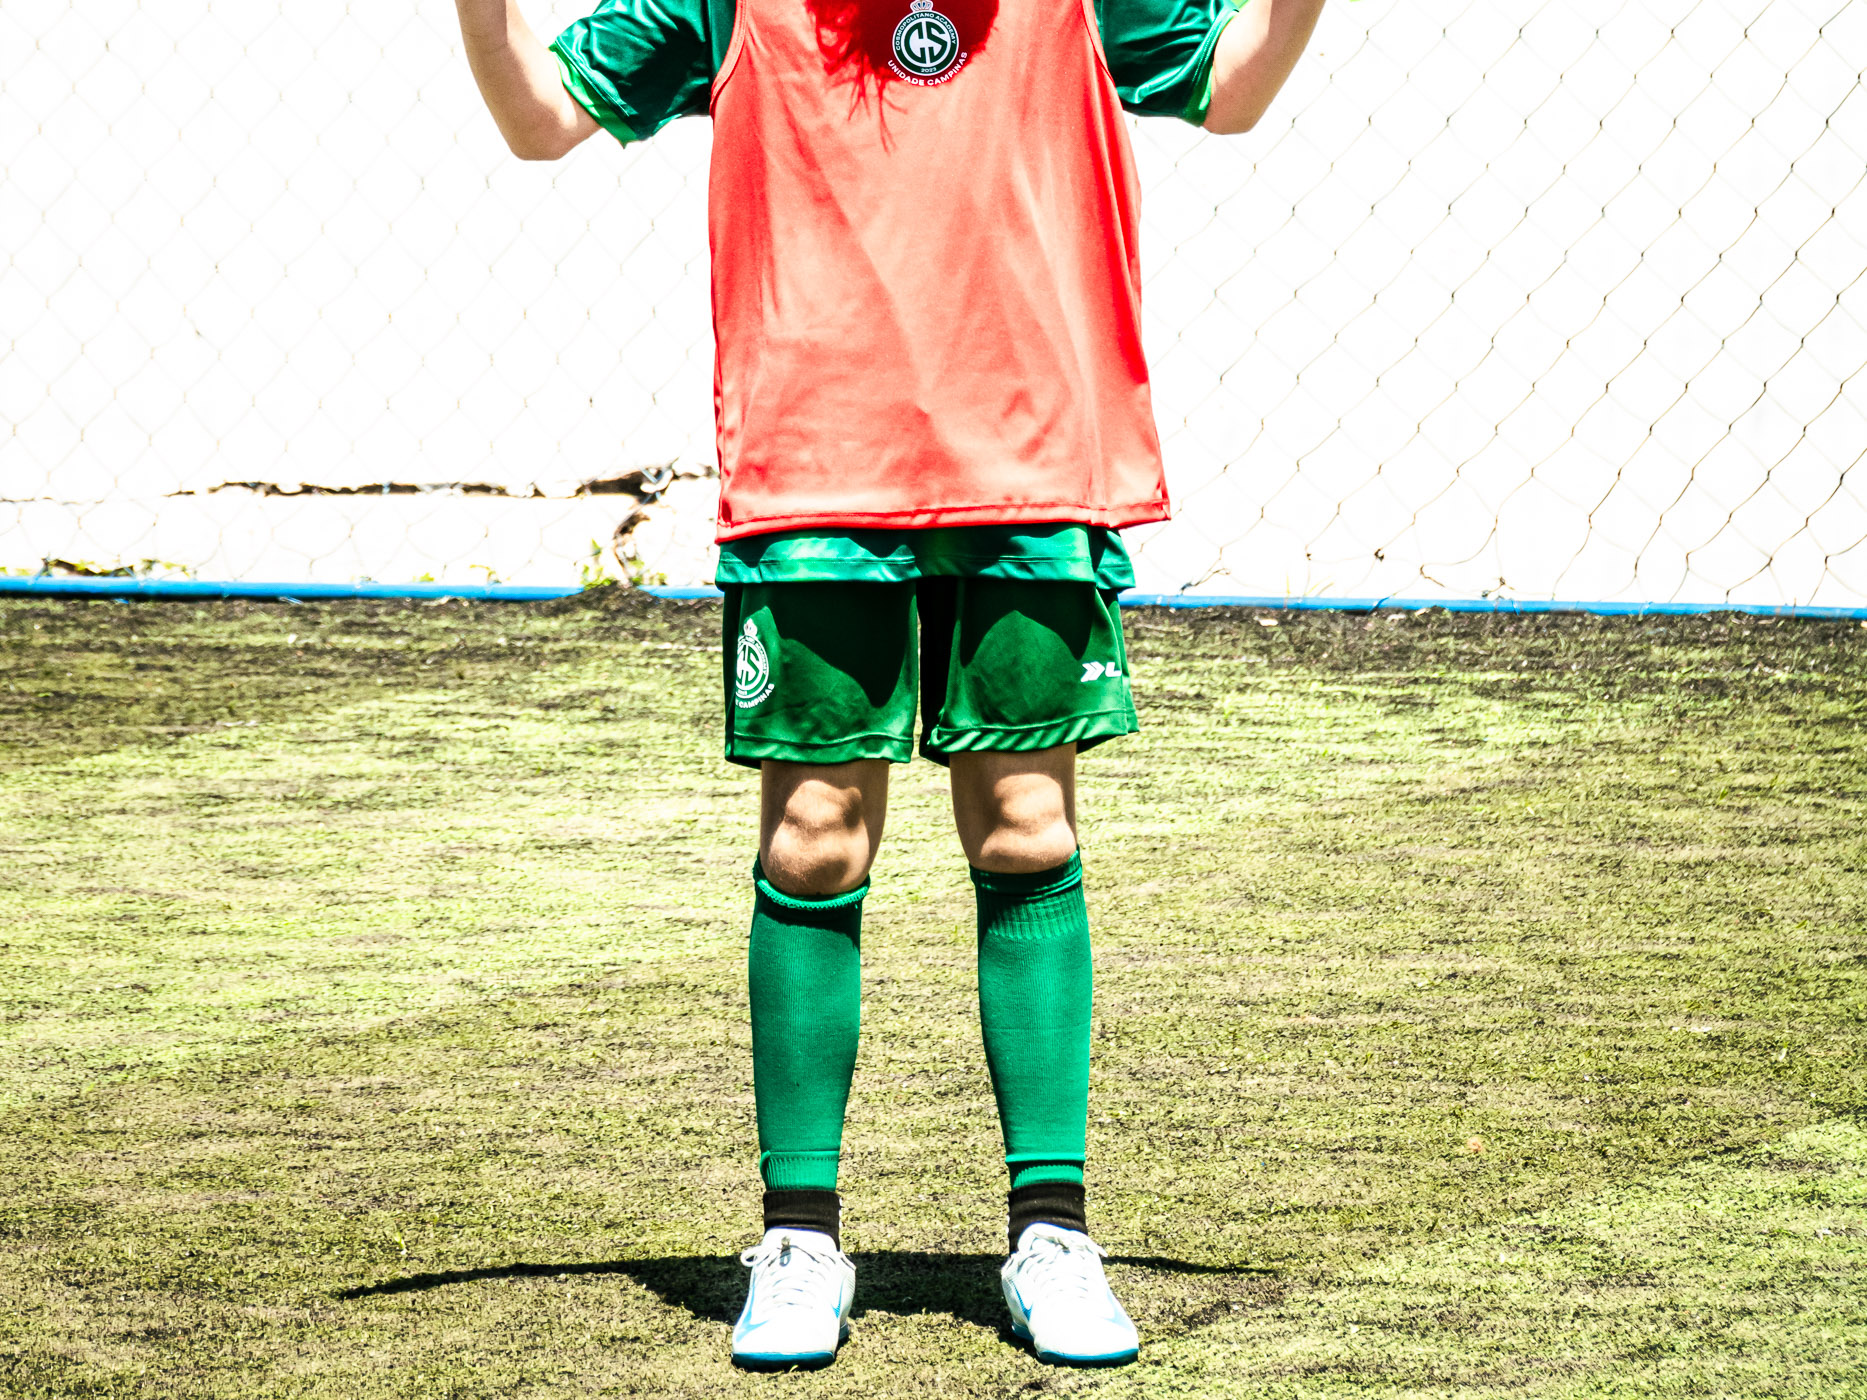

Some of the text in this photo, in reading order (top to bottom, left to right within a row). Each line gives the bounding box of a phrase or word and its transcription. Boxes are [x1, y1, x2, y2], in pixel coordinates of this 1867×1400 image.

[895, 13, 957, 51] COSMOPOLITANO ACADEMY
[904, 21, 948, 64] CS
[887, 52, 968, 86] UNIDADE CAMPINAS
